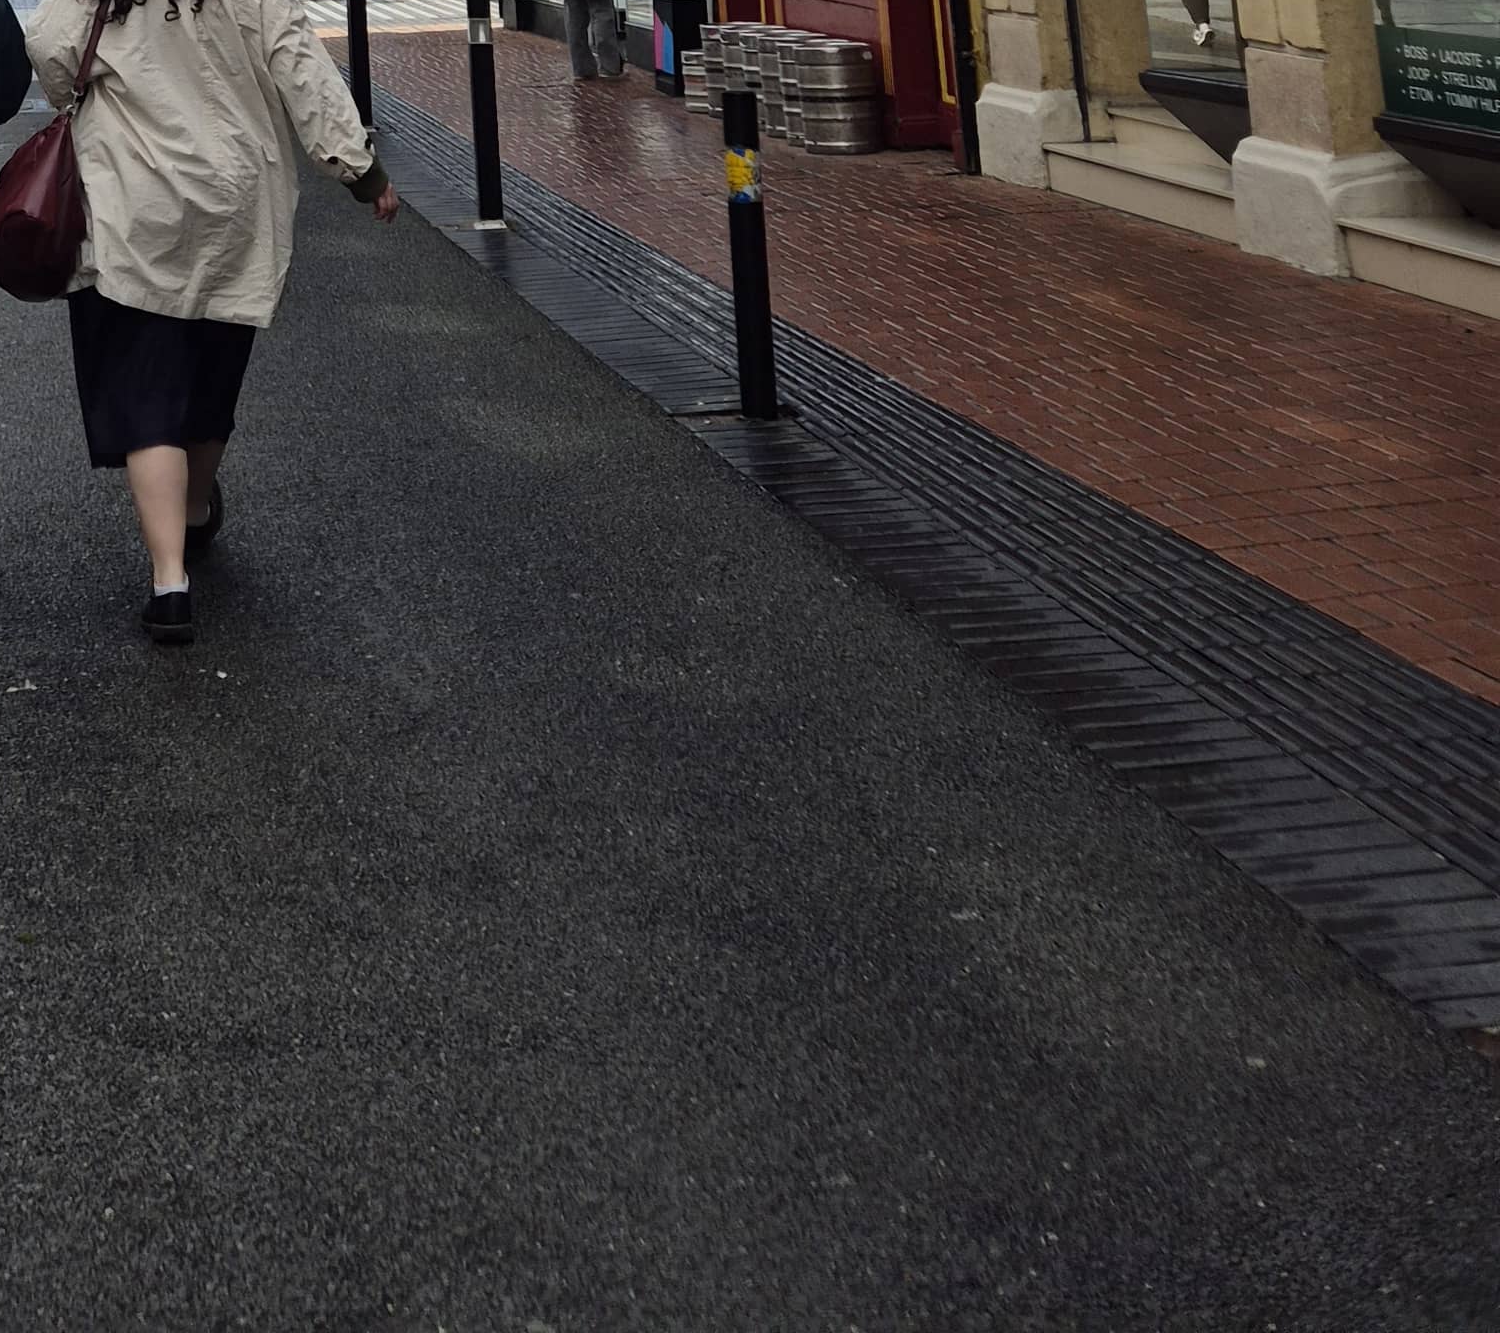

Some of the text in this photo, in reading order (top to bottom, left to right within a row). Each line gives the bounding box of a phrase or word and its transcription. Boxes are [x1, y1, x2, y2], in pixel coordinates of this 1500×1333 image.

[1403, 44, 1428, 60] BOSS
[1439, 49, 1483, 68] LACOSTE
[1407, 66, 1498, 91] JOOP STRELLSON
[1409, 85, 1434, 102] ETON
